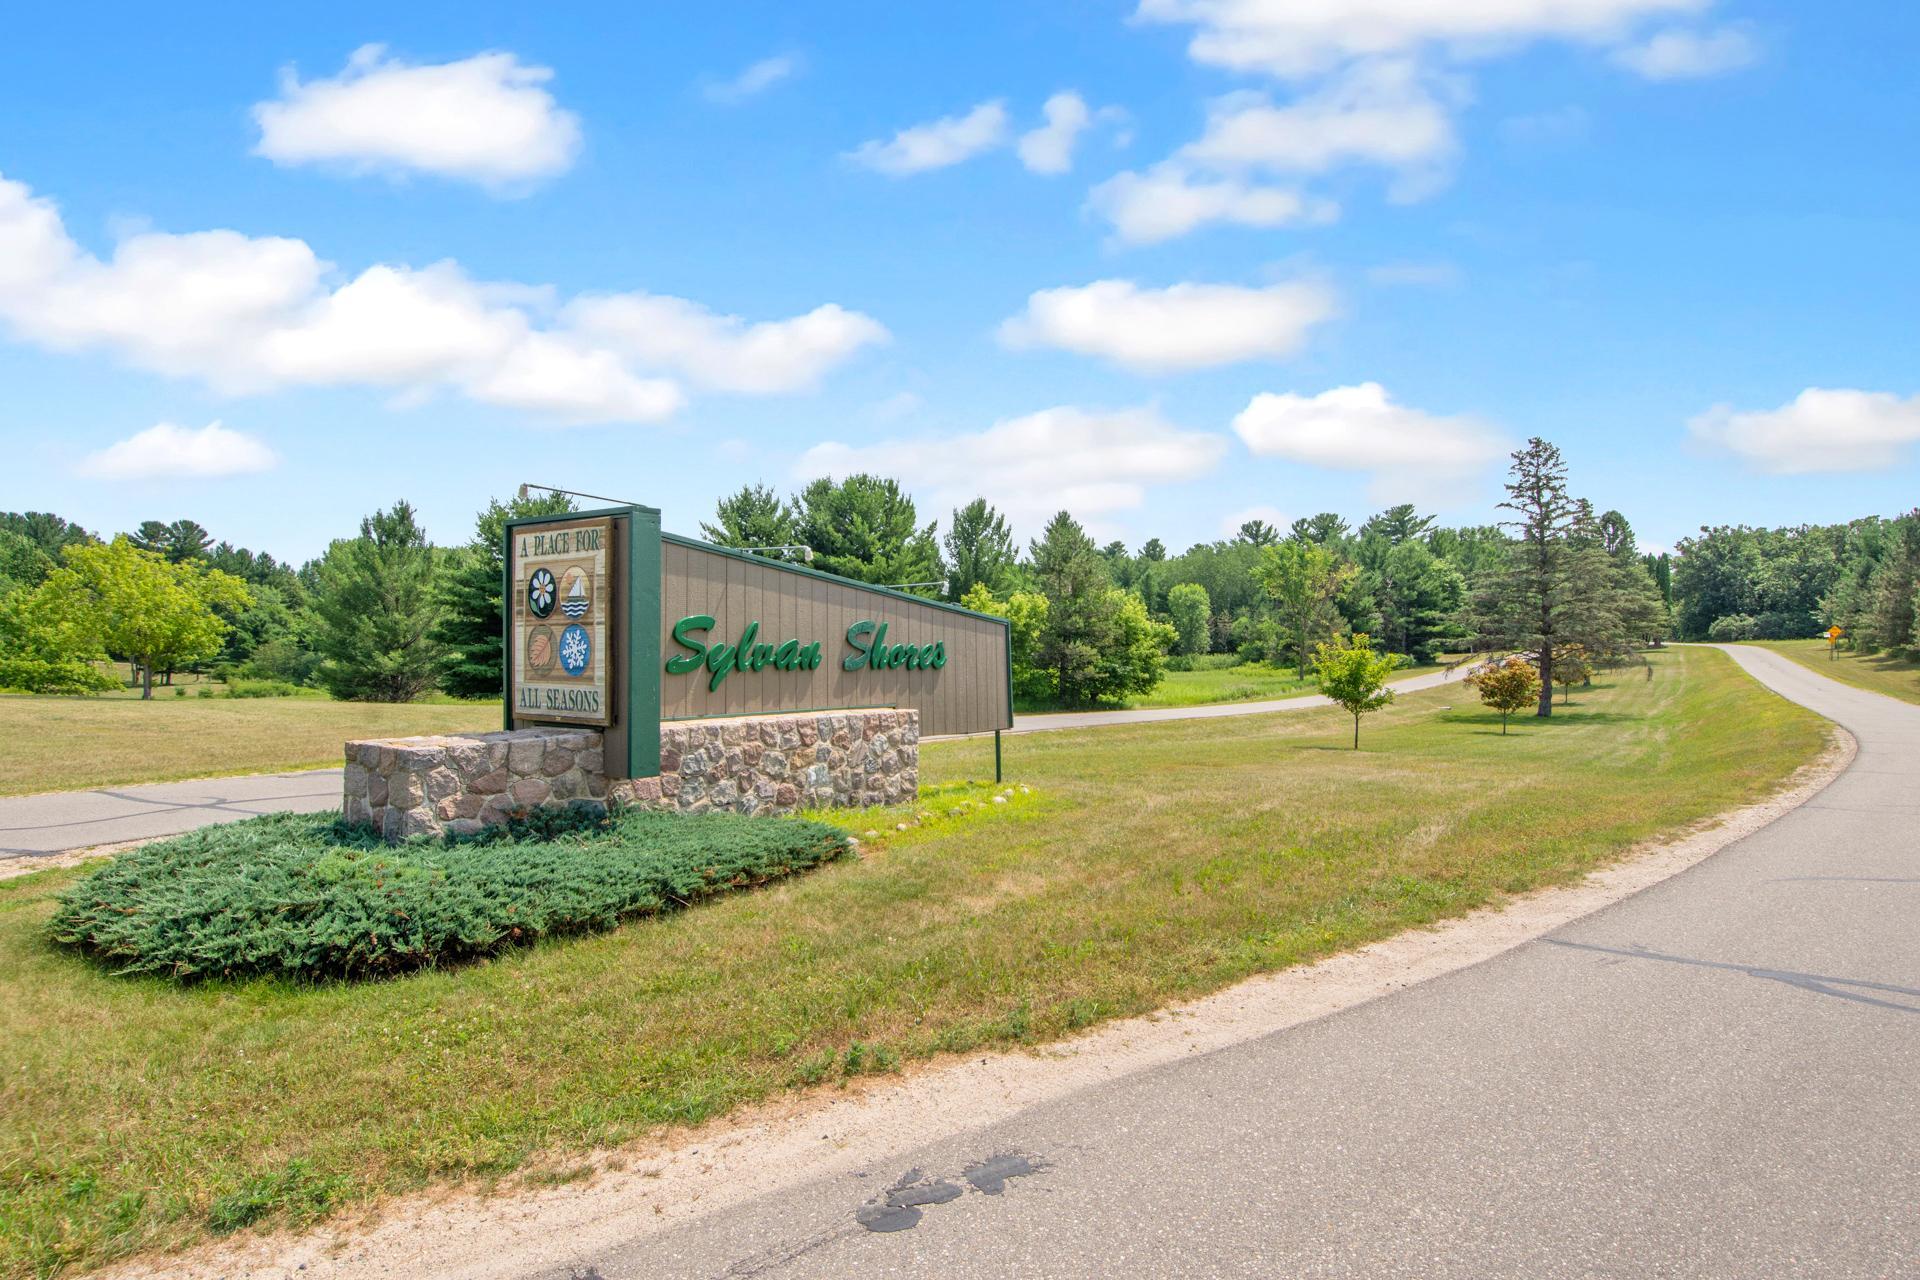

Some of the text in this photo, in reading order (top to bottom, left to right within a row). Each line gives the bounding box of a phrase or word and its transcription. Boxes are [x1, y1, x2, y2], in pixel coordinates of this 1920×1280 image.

[520, 528, 600, 558] A PLACE FOR
[666, 614, 947, 693] Sylvan Shores
[520, 688, 599, 713] ALL SEASONS
